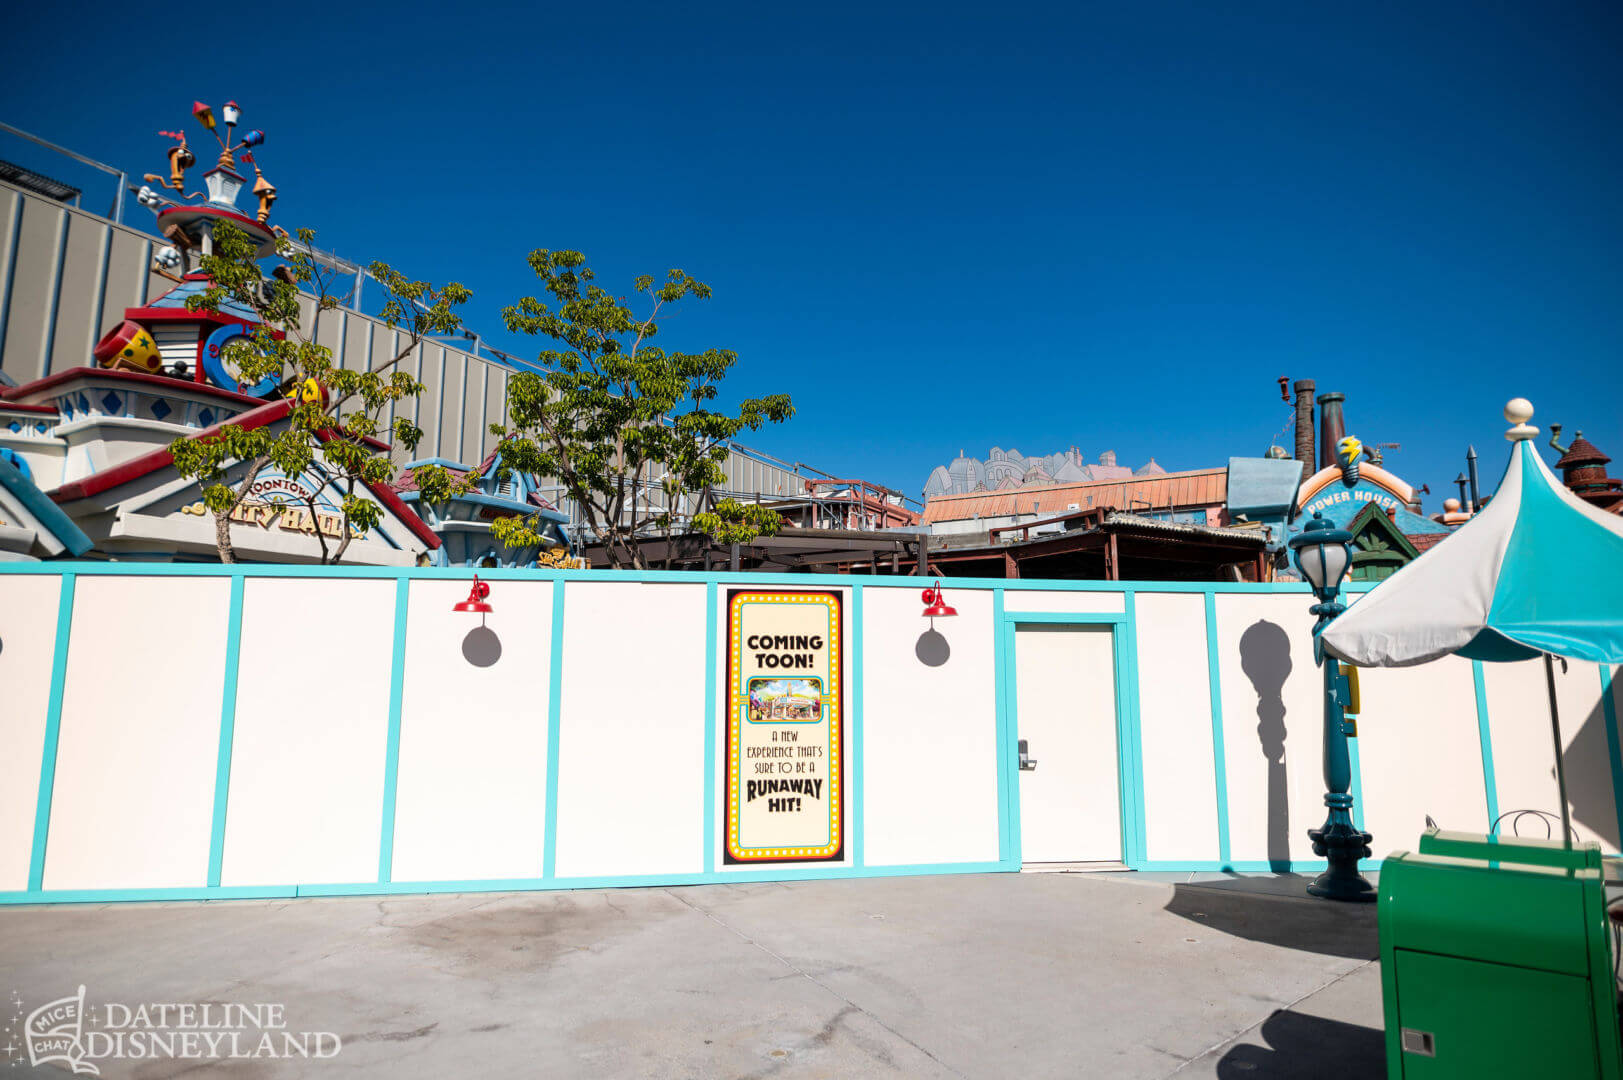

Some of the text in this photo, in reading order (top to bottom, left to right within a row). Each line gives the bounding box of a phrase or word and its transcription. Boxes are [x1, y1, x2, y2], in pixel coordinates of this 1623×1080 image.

[1307, 490, 1399, 515] POWER HOUSE
[230, 500, 344, 538] ITY HALL
[747, 635, 824, 650] COMING
[755, 653, 814, 668] TOON!
[772, 730, 799, 742] A NEW
[747, 745, 823, 758] EXPERIENCE THAT'S
[754, 761, 815, 774] SURE TO BE A
[747, 778, 823, 803] RUNAWAY
[768, 797, 801, 812] HIT!
